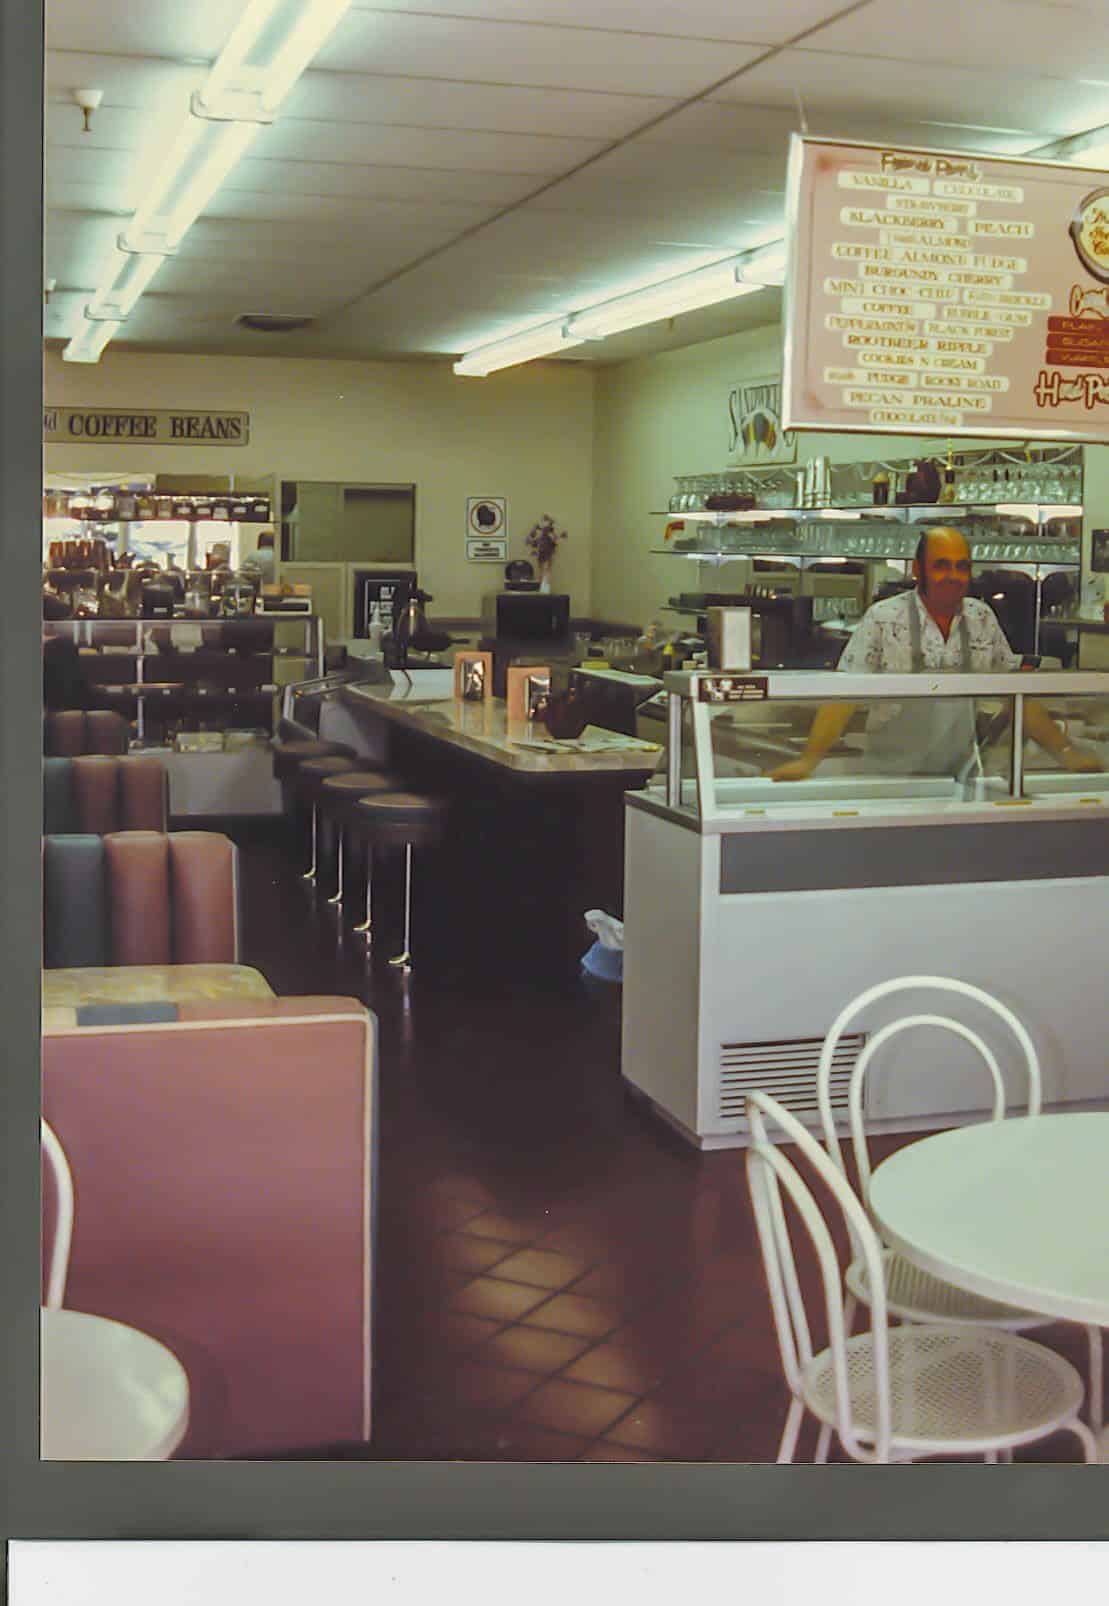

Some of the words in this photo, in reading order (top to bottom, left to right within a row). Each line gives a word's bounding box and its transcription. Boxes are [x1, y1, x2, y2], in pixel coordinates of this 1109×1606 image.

[850, 208, 945, 229] BLACKBERRY
[974, 222, 1030, 236] PEACH
[947, 273, 1003, 286] CHERRY
[850, 391, 903, 406] PECAN
[912, 393, 986, 410] PRALINE
[68, 413, 157, 437] COFFEE
[169, 415, 242, 439] BEANS
